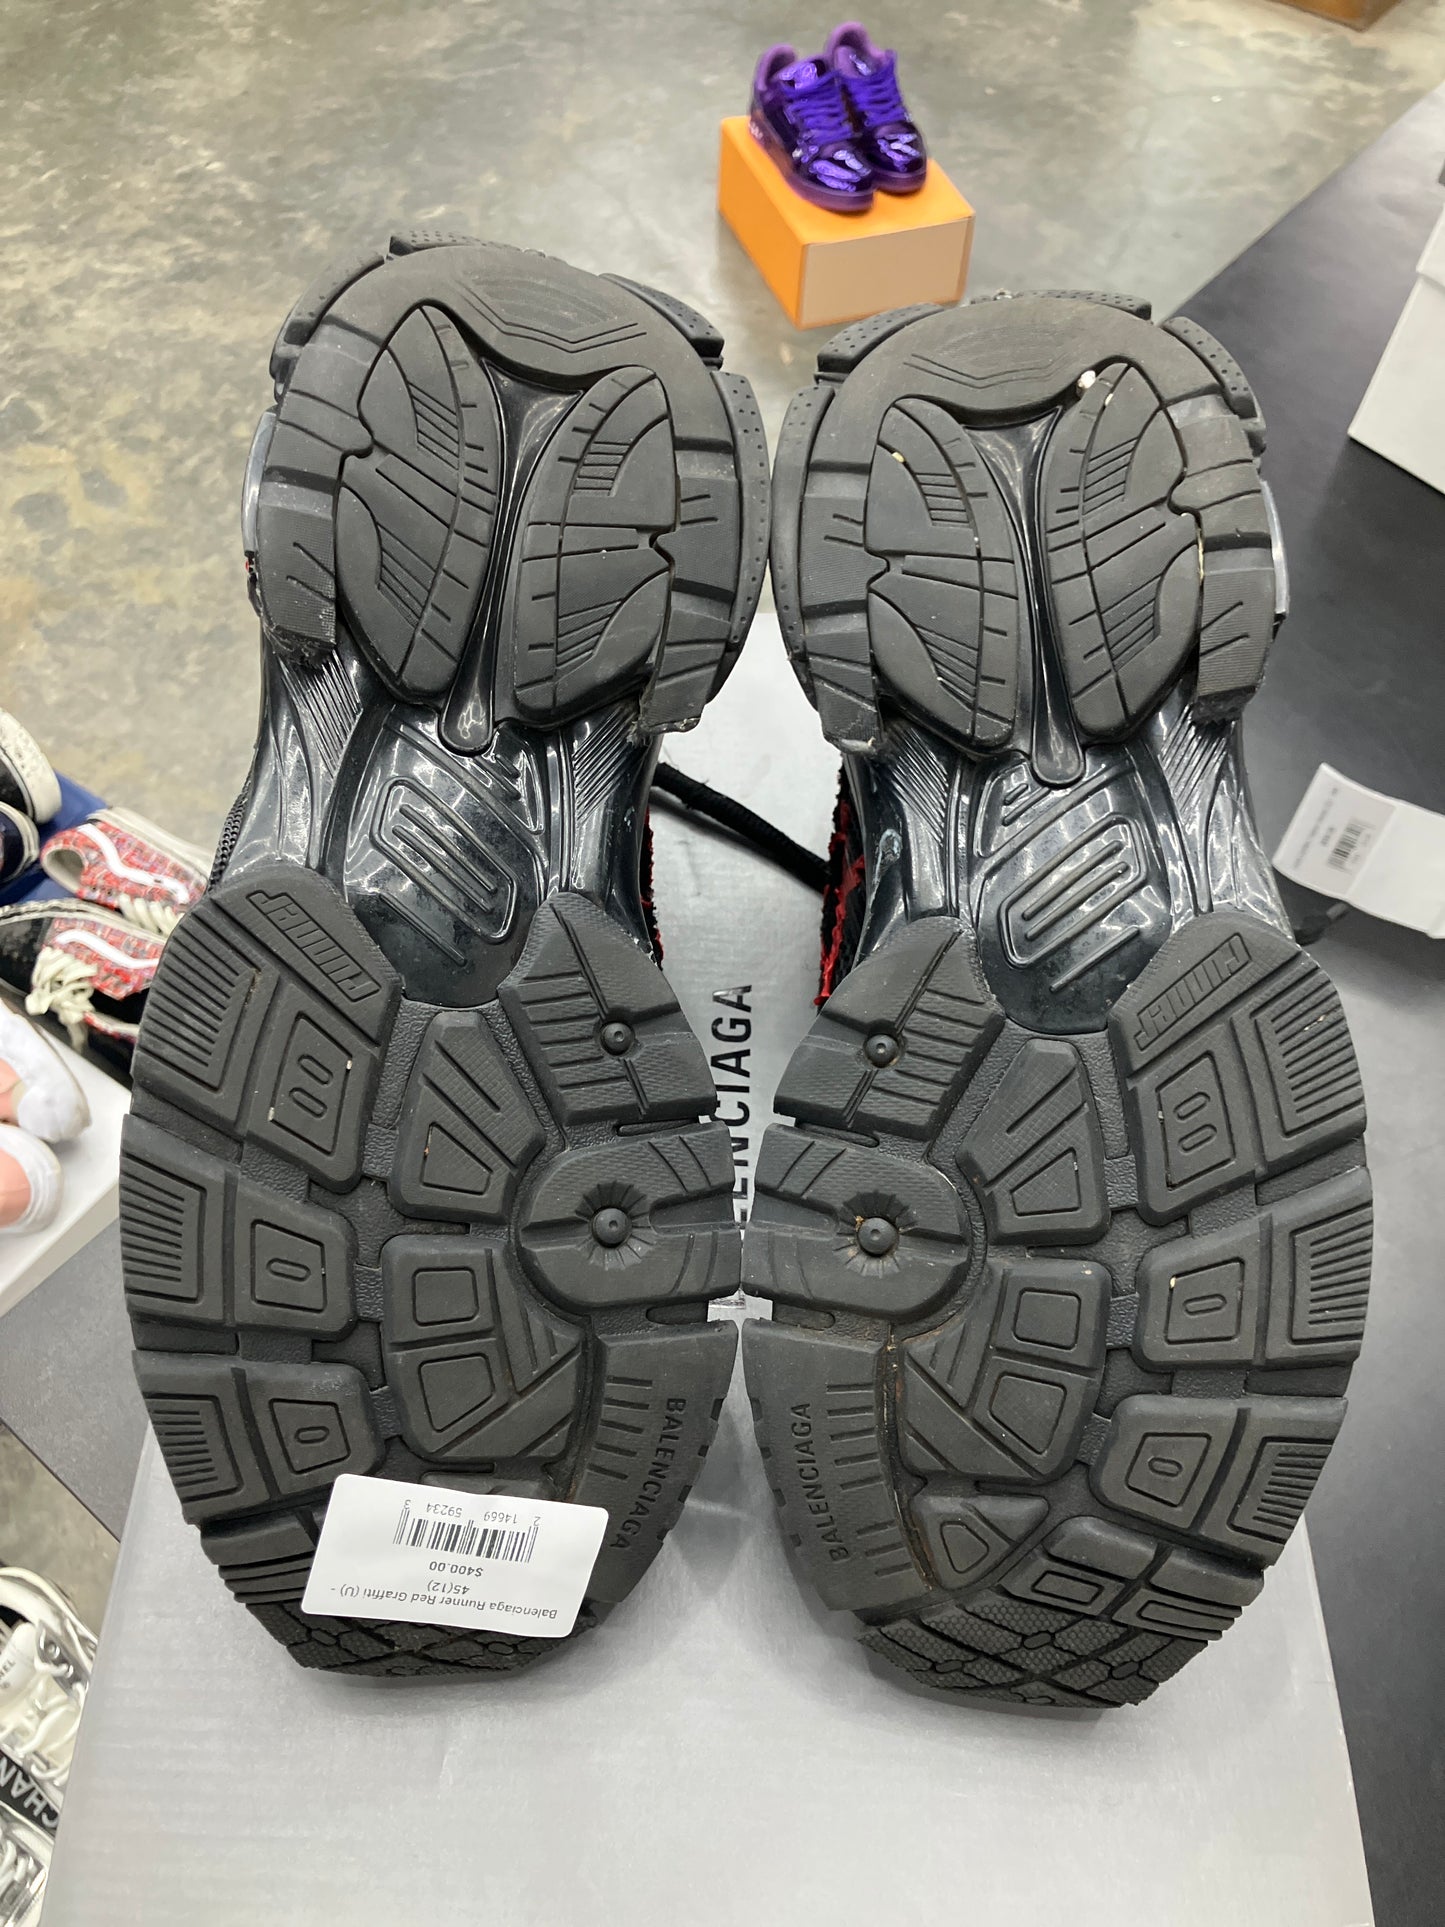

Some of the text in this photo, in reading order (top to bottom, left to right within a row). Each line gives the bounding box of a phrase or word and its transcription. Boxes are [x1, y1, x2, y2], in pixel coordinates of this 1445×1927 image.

[246, 889, 382, 1003] runner
[1133, 932, 1252, 1051] runner
[609, 1397, 688, 1550] BALENCIAGA
[790, 1402, 850, 1563] BALENCIAGA
[403, 1499, 541, 1527] 2 14669 59234 3
[428, 1560, 484, 1578] $400.00
[340, 1583, 360, 1598] (U)
[362, 1587, 408, 1602] Graffiti
[427, 1579, 470, 1596] 45(12)
[411, 1592, 436, 1606] Red
[439, 1594, 486, 1612] Runner
[489, 1599, 558, 1620] Balenciaga
